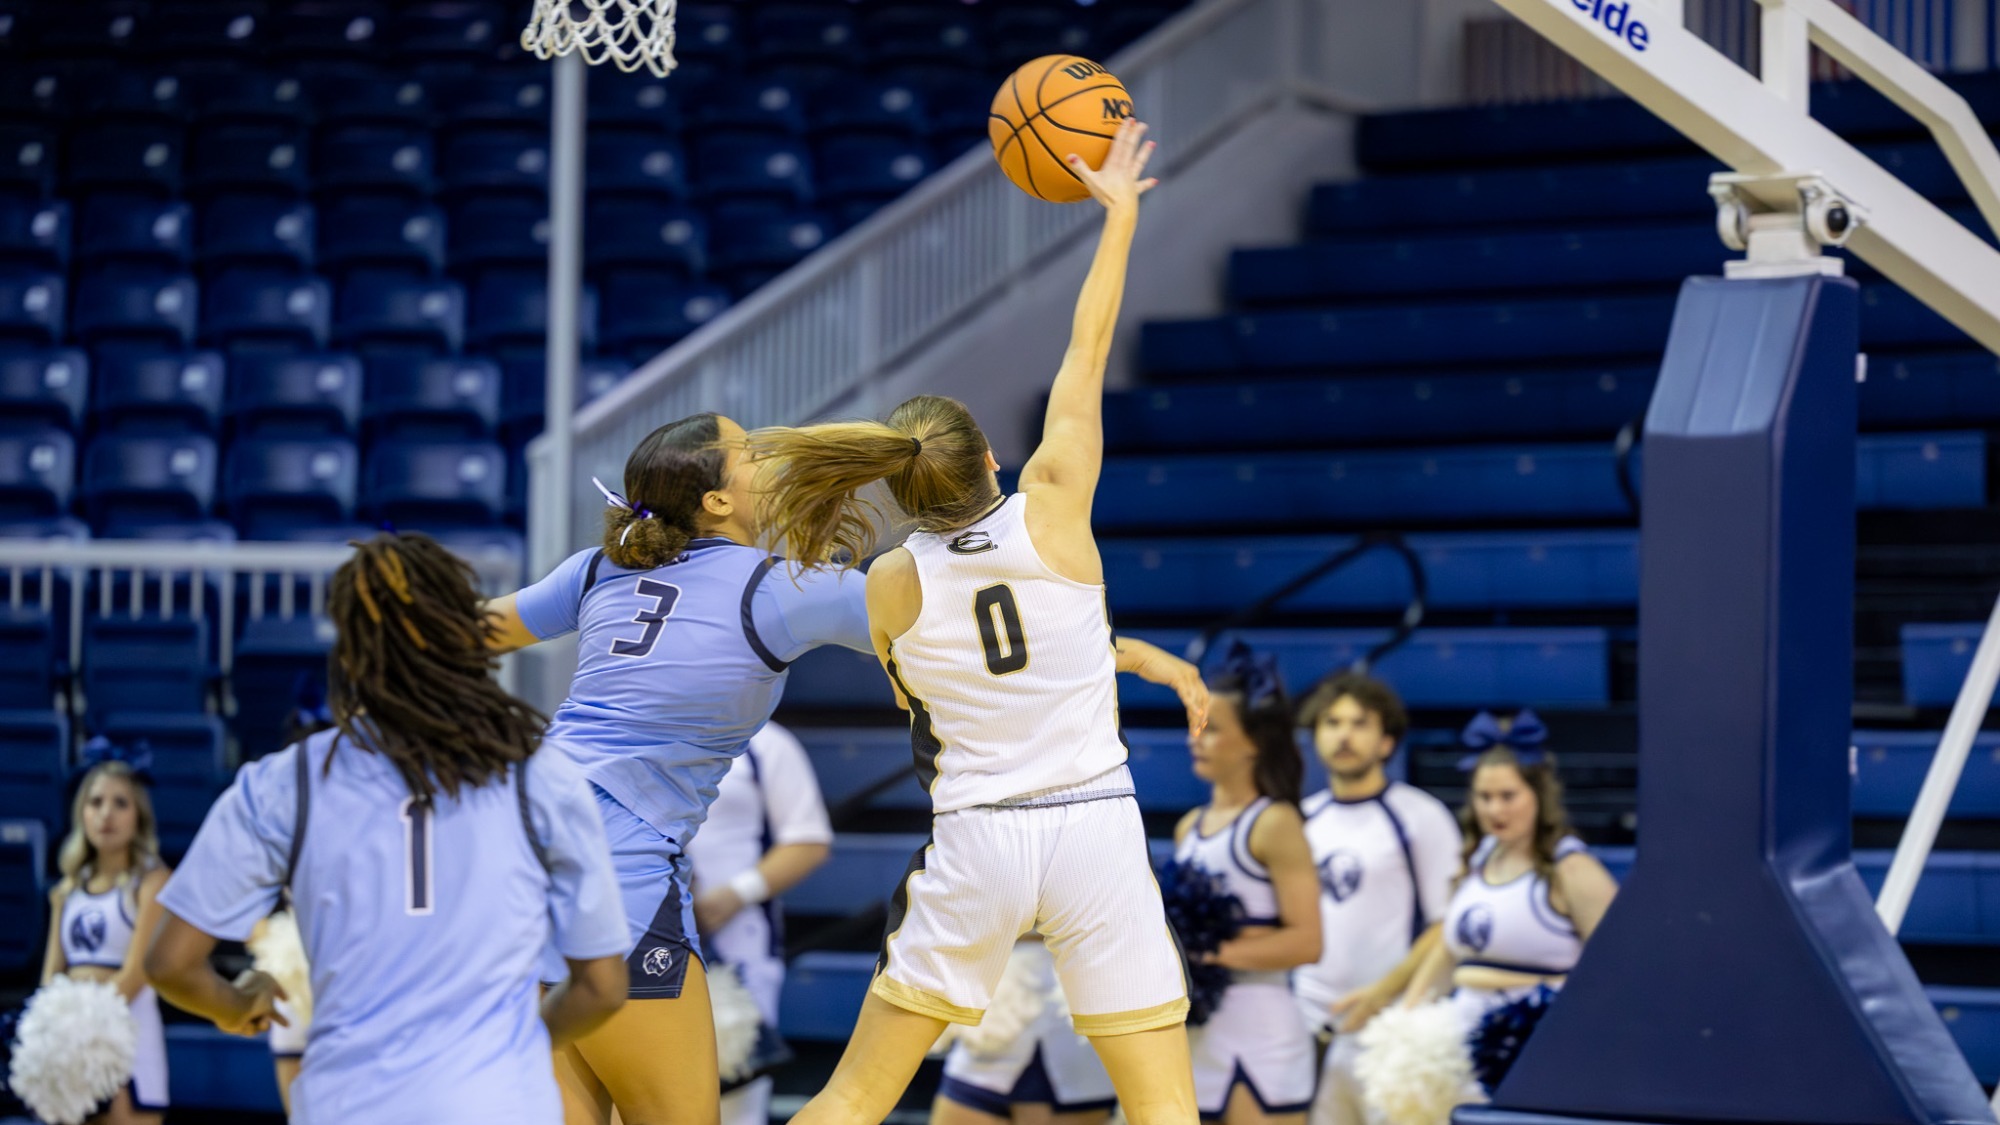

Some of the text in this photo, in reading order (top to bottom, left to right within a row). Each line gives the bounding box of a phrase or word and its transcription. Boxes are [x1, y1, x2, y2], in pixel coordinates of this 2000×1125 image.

[609, 576, 683, 659] 3
[971, 580, 1030, 678] 0
[400, 794, 434, 916] 1
